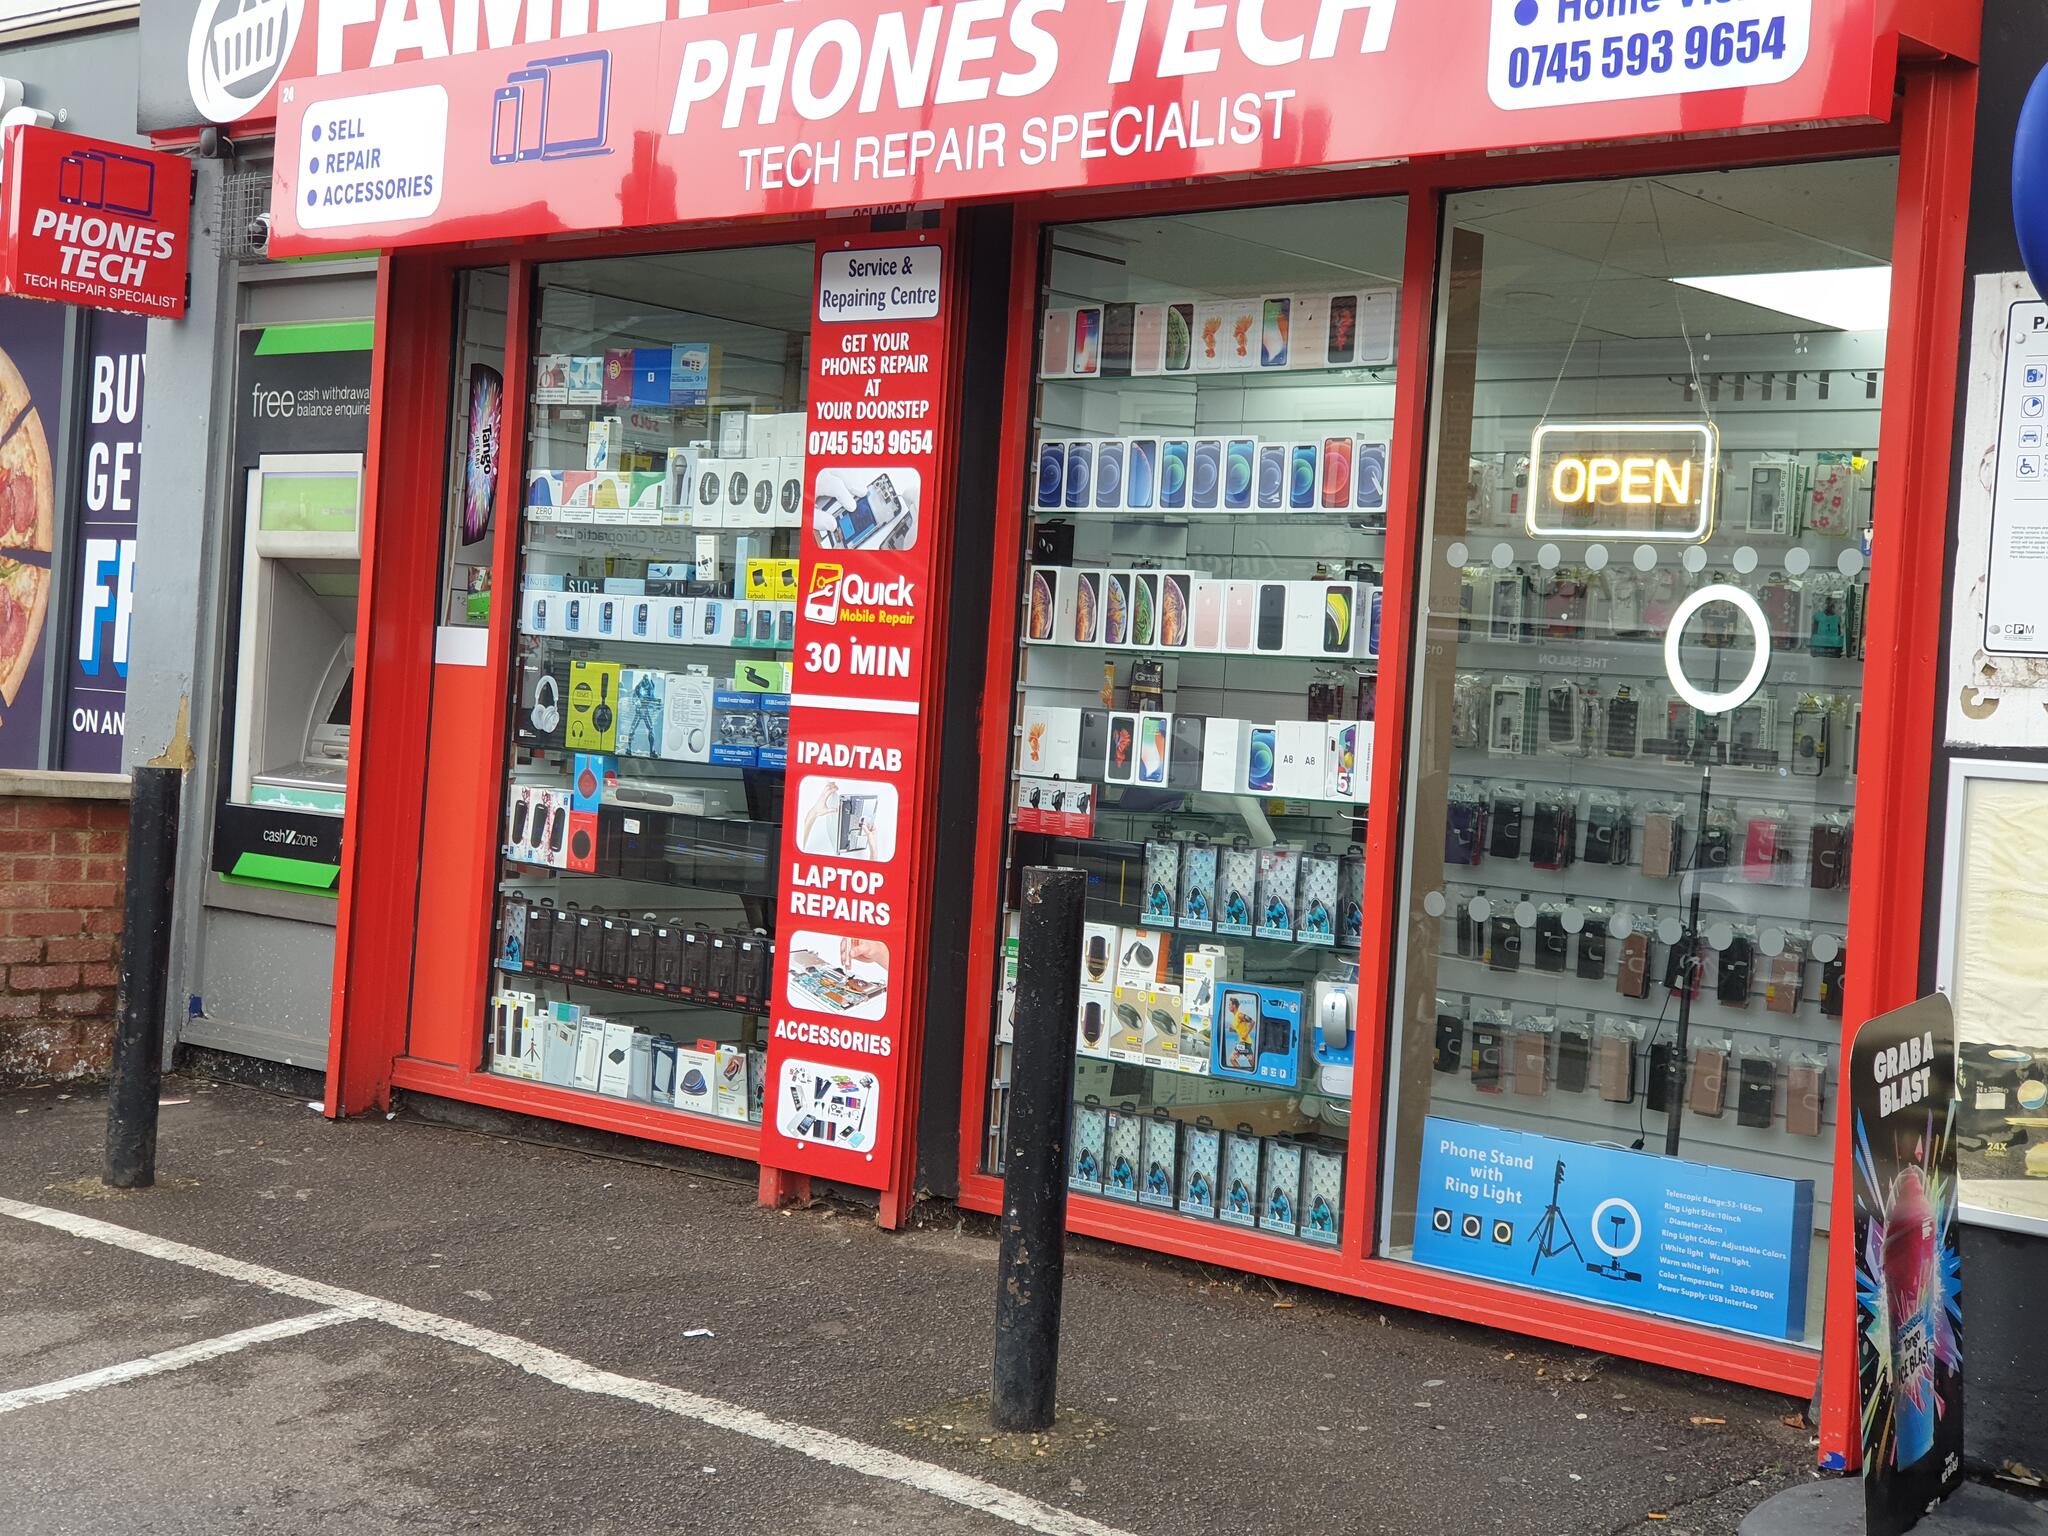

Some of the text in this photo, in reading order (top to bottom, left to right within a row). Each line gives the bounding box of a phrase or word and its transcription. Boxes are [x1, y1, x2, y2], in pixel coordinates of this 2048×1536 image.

[1508, 16, 1786, 88] 0745 593 9654
[667, 0, 1400, 135] PHONES TECH
[282, 86, 294, 103] 24
[328, 118, 365, 141] SELL
[738, 89, 1296, 191] TECH REPAIR SPECIALIST
[326, 148, 381, 174] REPAIR
[323, 175, 433, 206] ACCESSORIES
[32, 208, 175, 260] PHONES
[60, 245, 147, 287] TECH
[848, 256, 913, 277] Service &
[23, 272, 178, 309] TECH REPAIR SPECIALIST
[822, 286, 937, 313] Repairing Centre
[842, 332, 909, 353] GET YOUR
[821, 354, 928, 376] PHONES REPAIR
[252, 382, 295, 418] free
[297, 387, 319, 401] cash
[864, 379, 881, 397] AT
[296, 402, 333, 417] balance
[816, 400, 929, 420] YOUR DOORSTEP
[480, 424, 492, 475] Tango
[809, 430, 933, 455] 0745 593 9654
[86, 441, 142, 511] GE
[1551, 457, 1692, 505] OPEN
[535, 507, 553, 515] ZERO
[842, 573, 915, 607] Quick
[839, 608, 915, 627] Mobile Repair
[2004, 623, 2035, 635] CPM
[804, 642, 911, 677] 30 MIN
[72, 708, 99, 734] ON
[797, 741, 902, 772] IPAD/TAB
[1282, 754, 1294, 764] A8
[1304, 756, 1316, 766] A8
[263, 828, 318, 848] cash zone
[792, 863, 885, 896] LAPTOP
[790, 890, 891, 925] REPAIRS
[774, 1019, 892, 1057] ACCESSORIES
[1873, 1031, 1935, 1084] GRAB A
[1879, 1066, 1931, 1118] BLAST
[1440, 1140, 1534, 1170] Phone Stand
[1986, 1142, 2008, 1151] 24X
[1470, 1166, 1504, 1183] with
[1445, 1176, 1523, 1205] Ring Light
[1665, 1189, 1702, 1203] Telescopic
[1664, 1202, 1680, 1213] Ring
[1681, 1204, 1700, 1216] Light
[1661, 1229, 1678, 1240] Ring
[1679, 1231, 1698, 1243] Light
[1721, 1240, 1761, 1255] Adjustable
[1761, 1247, 1787, 1260] Colors
[1686, 1246, 1704, 1258] light
[1709, 1252, 1731, 1263] Warm
[1658, 1269, 1678, 1280] Color
[1659, 1255, 1681, 1267] Warm
[1681, 1260, 1701, 1271] white
[1657, 1282, 1680, 1294] Power
[1708, 1293, 1724, 1303] USB
[1909, 1340, 1929, 1374] BLAST
